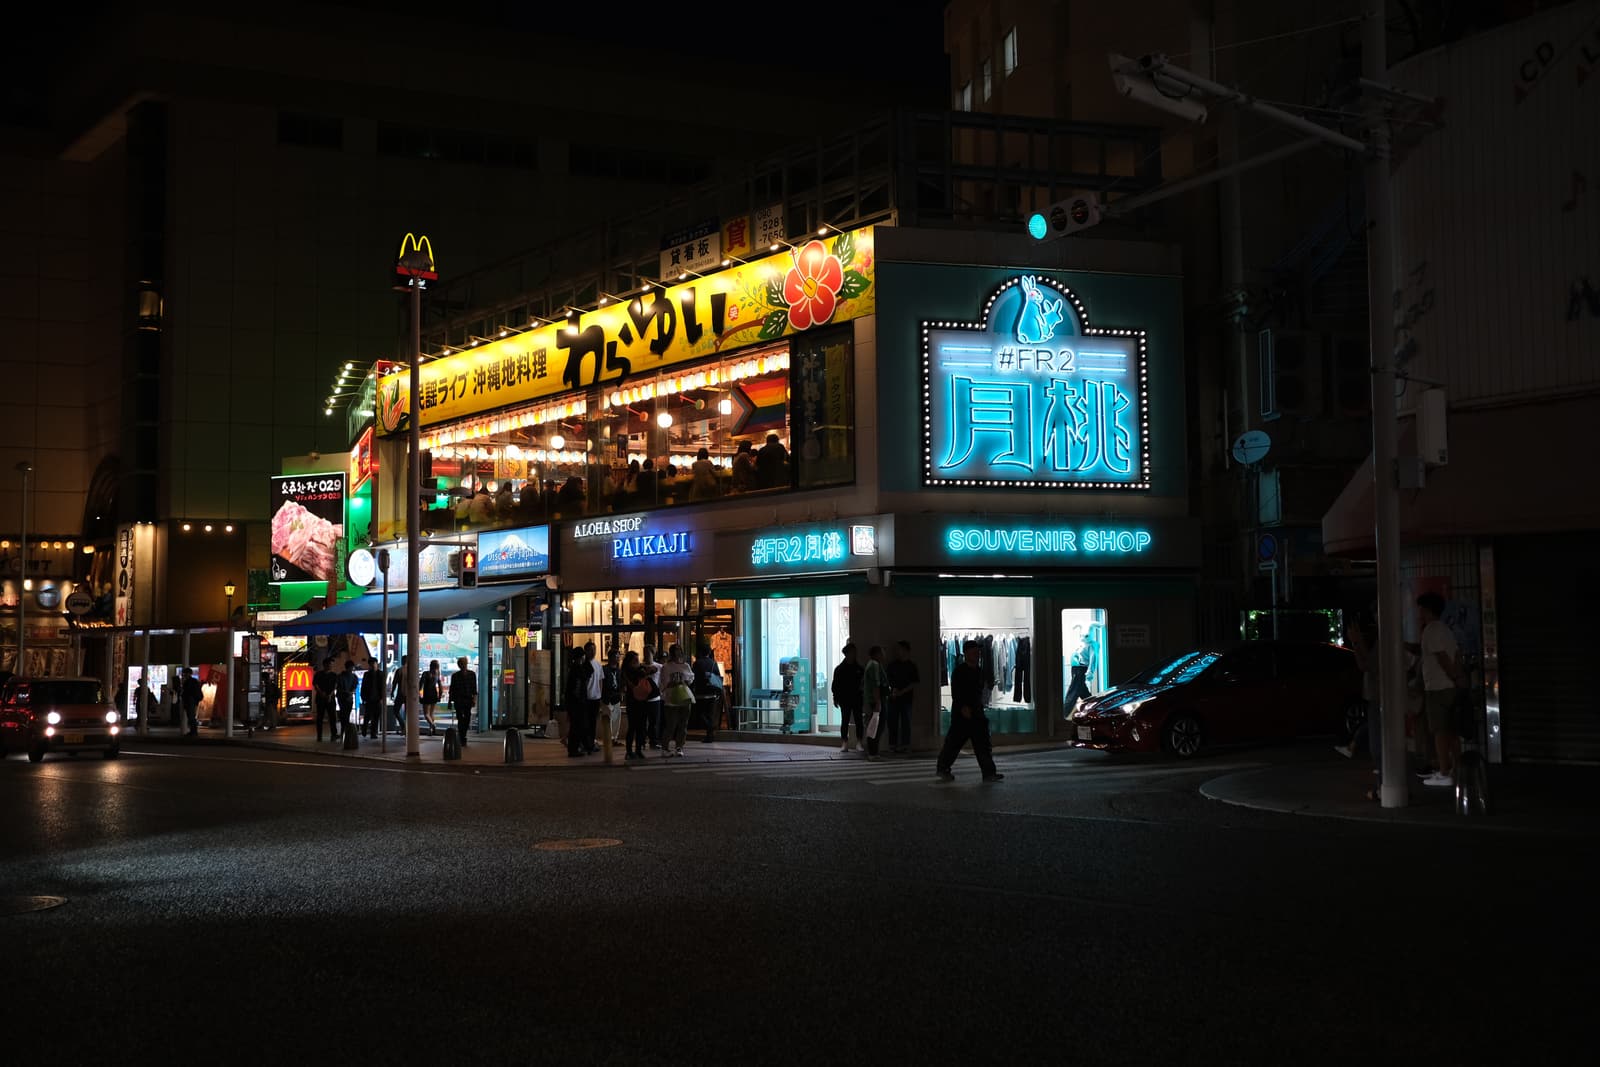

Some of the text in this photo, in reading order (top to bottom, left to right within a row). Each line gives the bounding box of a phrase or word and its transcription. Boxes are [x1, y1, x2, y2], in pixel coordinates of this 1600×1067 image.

[726, 216, 746, 253] 貸
[670, 238, 710, 267] 貸看板
[473, 347, 547, 395] 沖縄地料理
[999, 348, 1075, 373] #FR2
[938, 373, 1131, 473] 月桃
[573, 517, 642, 538] ALOHA SHOP
[948, 529, 1151, 552] SOUVENIR SHOP
[613, 532, 688, 559] PAIKAJI
